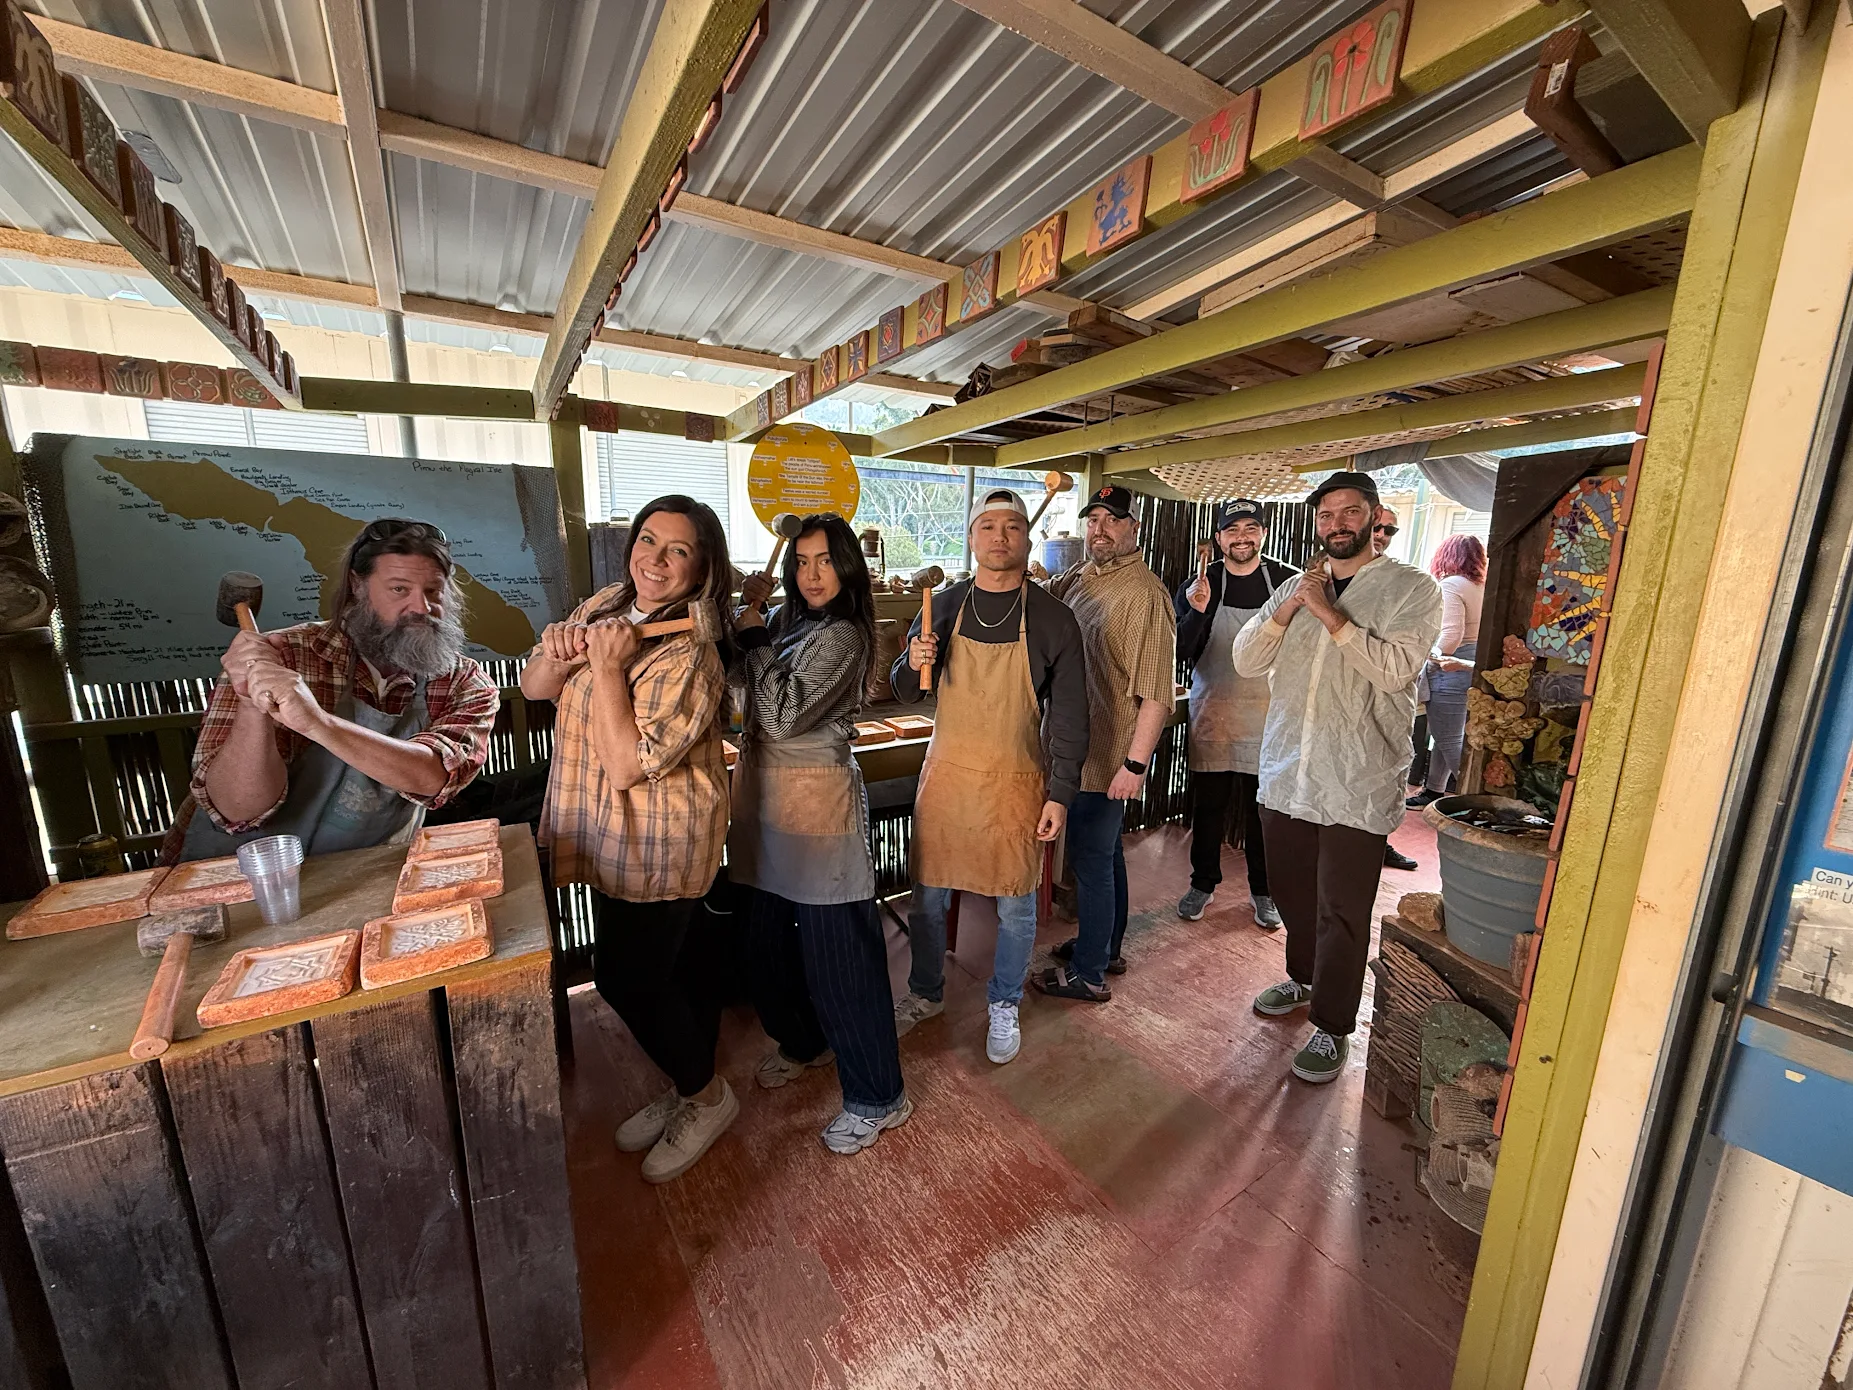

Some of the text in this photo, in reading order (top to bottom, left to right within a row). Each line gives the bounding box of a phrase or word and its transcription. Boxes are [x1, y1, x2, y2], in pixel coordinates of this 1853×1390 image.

[192, 450, 213, 458] Arrow
[213, 450, 232, 458] Point
[252, 466, 263, 474] Bay
[438, 463, 453, 473] the
[308, 486, 324, 495] Cove
[118, 622, 132, 630] 54
[1815, 870, 1843, 886] Can
